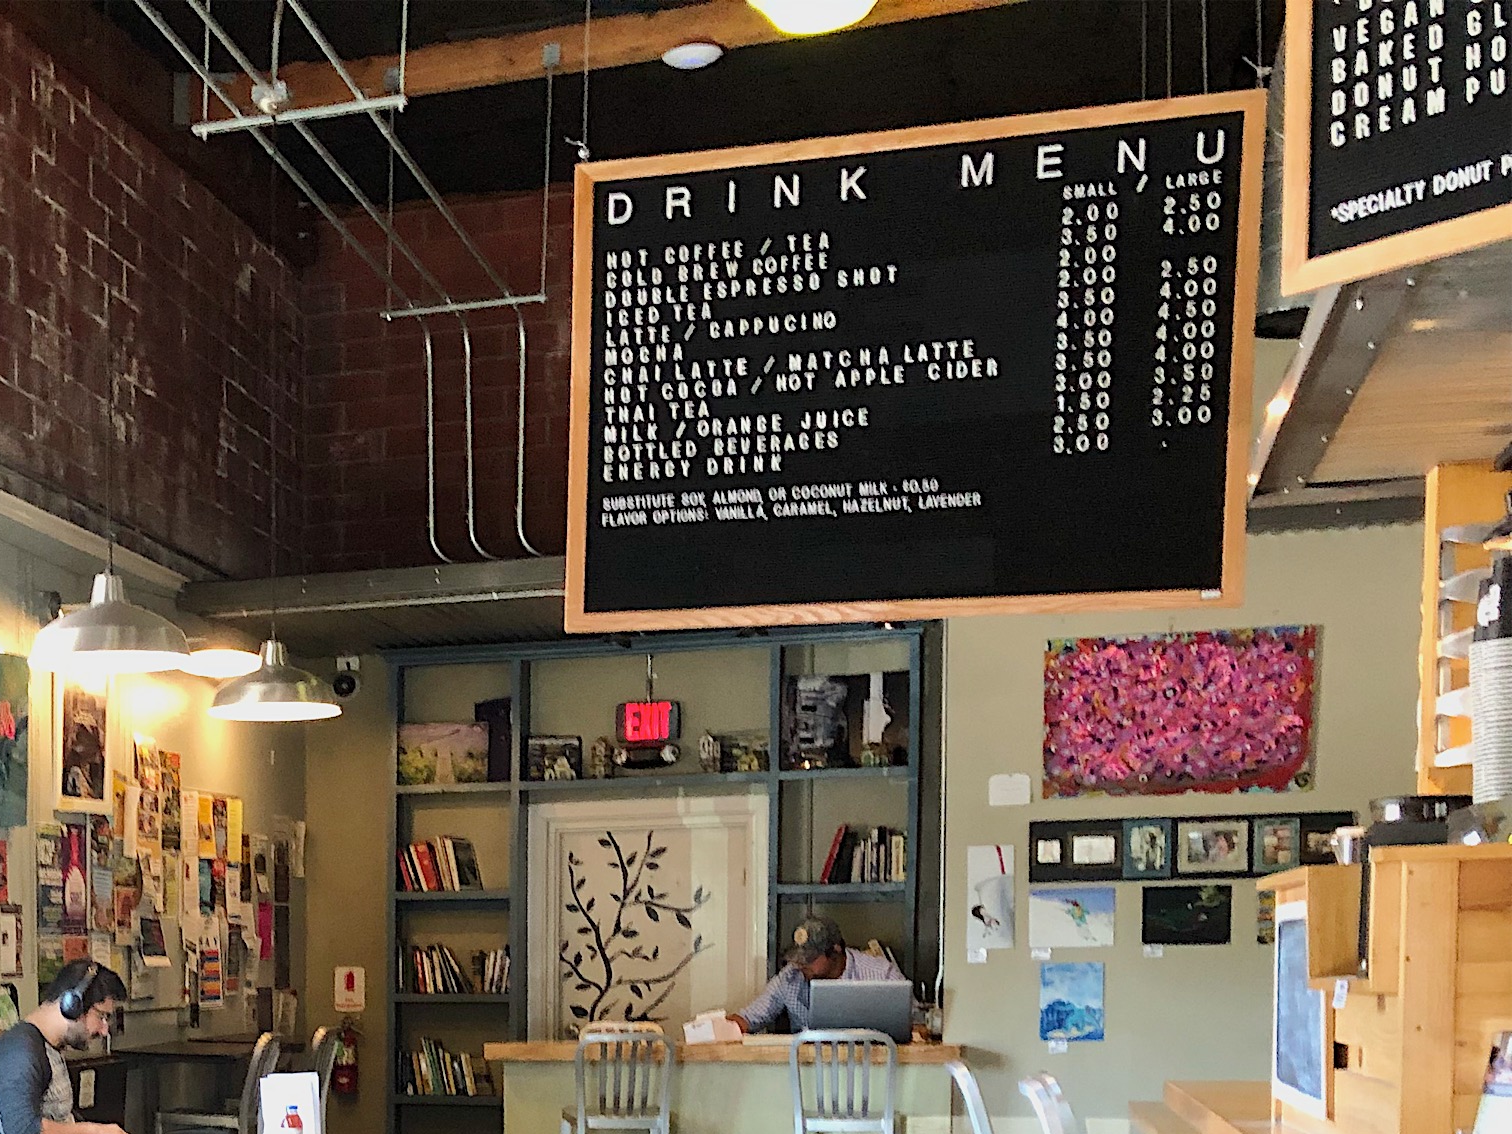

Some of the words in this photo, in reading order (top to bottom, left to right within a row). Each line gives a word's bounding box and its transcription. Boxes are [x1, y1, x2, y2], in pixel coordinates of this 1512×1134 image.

[1331, 23, 1443, 84] BAKED
[1330, 86, 1446, 147] CREAM
[1331, 56, 1443, 117] DONUT
[608, 166, 867, 225] DRINK
[961, 130, 1225, 187] MENU
[1063, 182, 1117, 200] SMALL
[1166, 169, 1222, 189] LARGE
[1432, 159, 1494, 196] DONUT
[607, 249, 648, 269] HOT
[665, 240, 743, 264] COFFEE
[787, 232, 829, 252] TEA
[1062, 202, 1118, 225] 2.00
[1164, 191, 1221, 215] 2.50
[607, 268, 662, 289] COLD
[678, 261, 738, 282] BREW
[753, 252, 827, 275] COFFEE
[1061, 223, 1116, 245] 3.50
[1163, 213, 1219, 234] 4.00
[605, 285, 688, 308] DOUBLE
[704, 272, 820, 300] ESPRESSO
[838, 265, 897, 288] SHOT
[1060, 245, 1116, 267] 2.00
[607, 306, 659, 327] ICED
[673, 302, 711, 321] TEA
[1059, 265, 1115, 287] 2.00
[1161, 256, 1217, 278] 2.50
[605, 343, 682, 366] MOCHA
[1057, 307, 1114, 329] 4.00
[1158, 299, 1216, 320] 4.50
[606, 325, 670, 347] LATTE
[710, 311, 836, 338] CAPPUCINO
[1057, 287, 1114, 308] 3.50
[1160, 278, 1216, 299] 4.00
[604, 365, 660, 385] CHAI
[675, 358, 747, 380] LATTE
[789, 347, 889, 371] MATCHA
[904, 340, 974, 363] LATTE
[1057, 329, 1111, 350] 3.50
[1156, 320, 1215, 342] 4.00
[605, 385, 647, 404] HOT
[662, 378, 736, 400] COCOA
[776, 372, 815, 392] HOT
[835, 365, 904, 388] APPLE
[928, 358, 997, 380] CIDER
[1055, 349, 1111, 371] 3.50
[1155, 341, 1214, 362] 4.00
[604, 423, 657, 443] MILK
[697, 414, 782, 437] ORANGE
[801, 408, 868, 429] JUICE
[1057, 392, 1109, 412] 1.50
[1153, 384, 1210, 405] 2.25
[605, 403, 654, 424] THAI
[669, 400, 709, 420] TEA
[1056, 371, 1111, 392] 3.00
[1154, 363, 1213, 384] 3.50
[603, 460, 690, 482] ENERGY
[707, 454, 781, 475] DRINK
[1054, 433, 1108, 454] 3.00
[604, 440, 697, 463] BOTTLED
[714, 431, 838, 456] BEVERAGES
[1054, 412, 1109, 434] 2.50
[1152, 405, 1211, 426] 3.00
[601, 510, 648, 527] FLAVOR
[918, 491, 982, 510] LAVENDER
[602, 492, 675, 511] SUBSTITUTE
[768, 486, 787, 502] OR
[791, 482, 853, 500] COCONUT
[859, 480, 888, 497] MILK
[625, 701, 672, 742] EXIT
